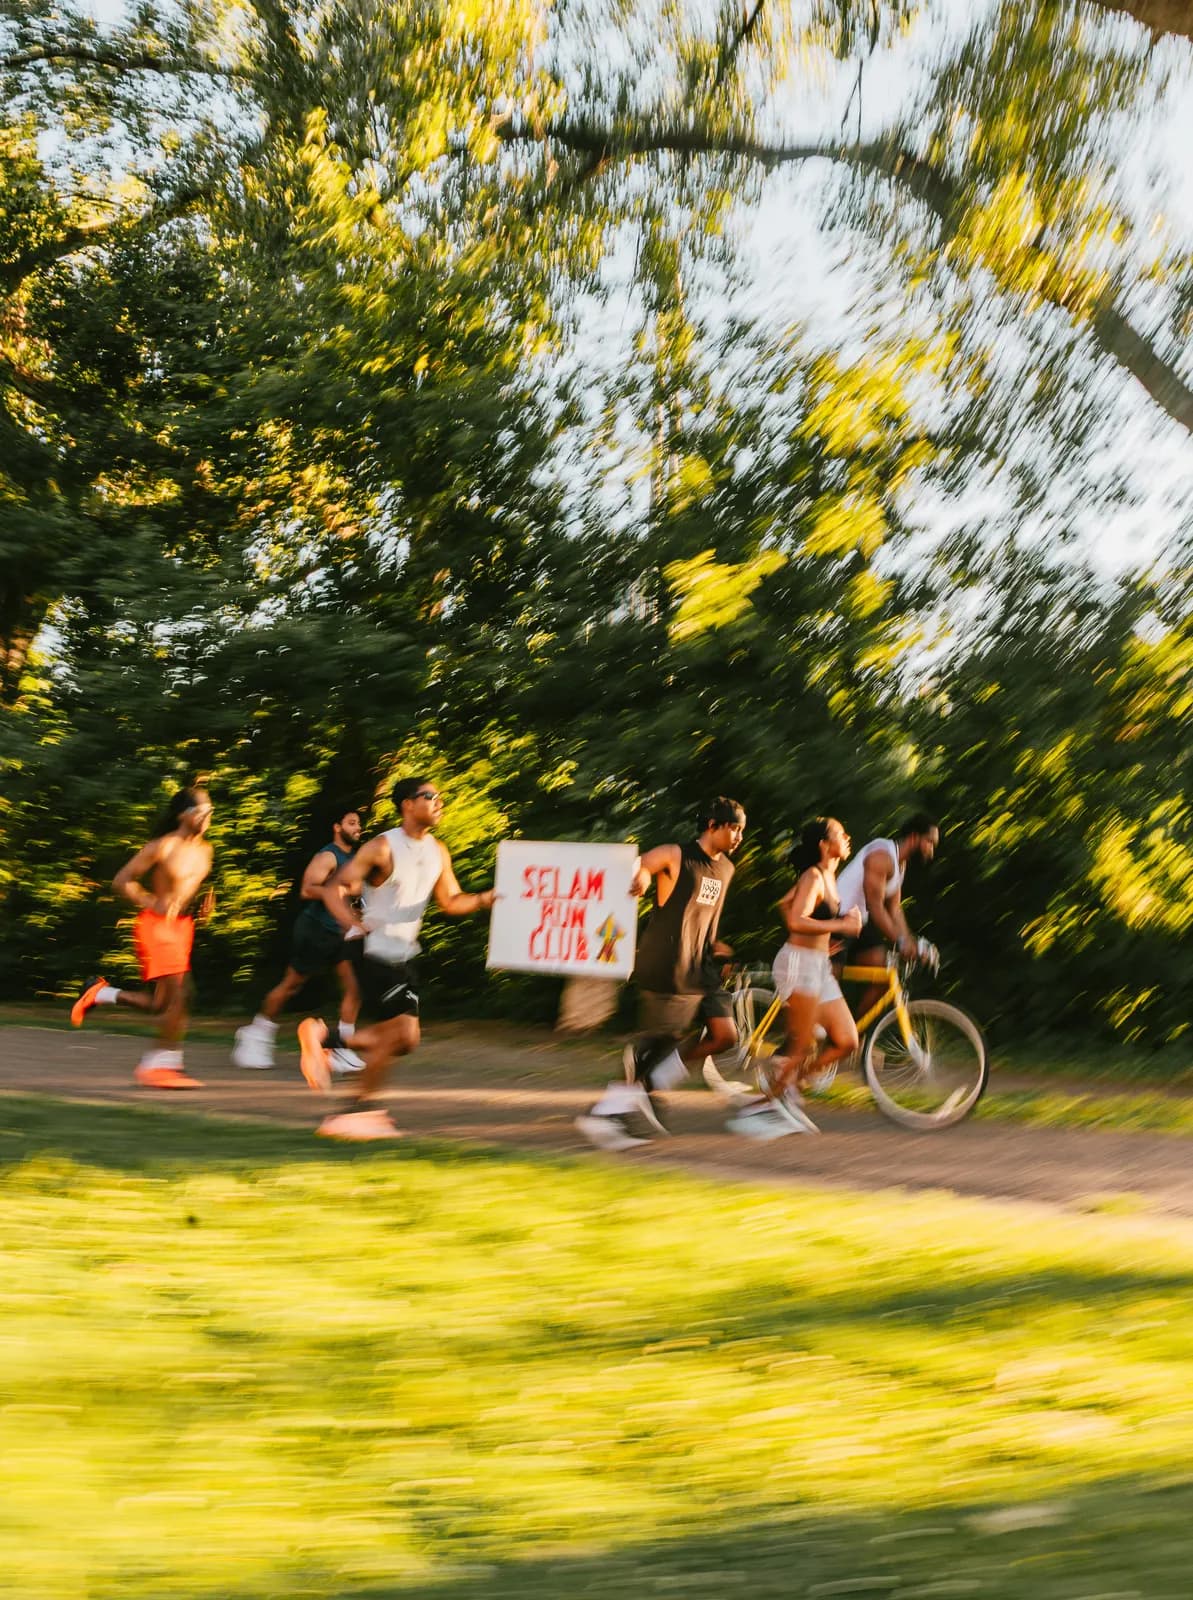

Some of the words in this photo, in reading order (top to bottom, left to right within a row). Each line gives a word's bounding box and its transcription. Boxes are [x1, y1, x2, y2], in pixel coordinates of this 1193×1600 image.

[521, 864, 606, 901] SELAM
[541, 899, 587, 928] RUN
[528, 926, 590, 961] CLUB
